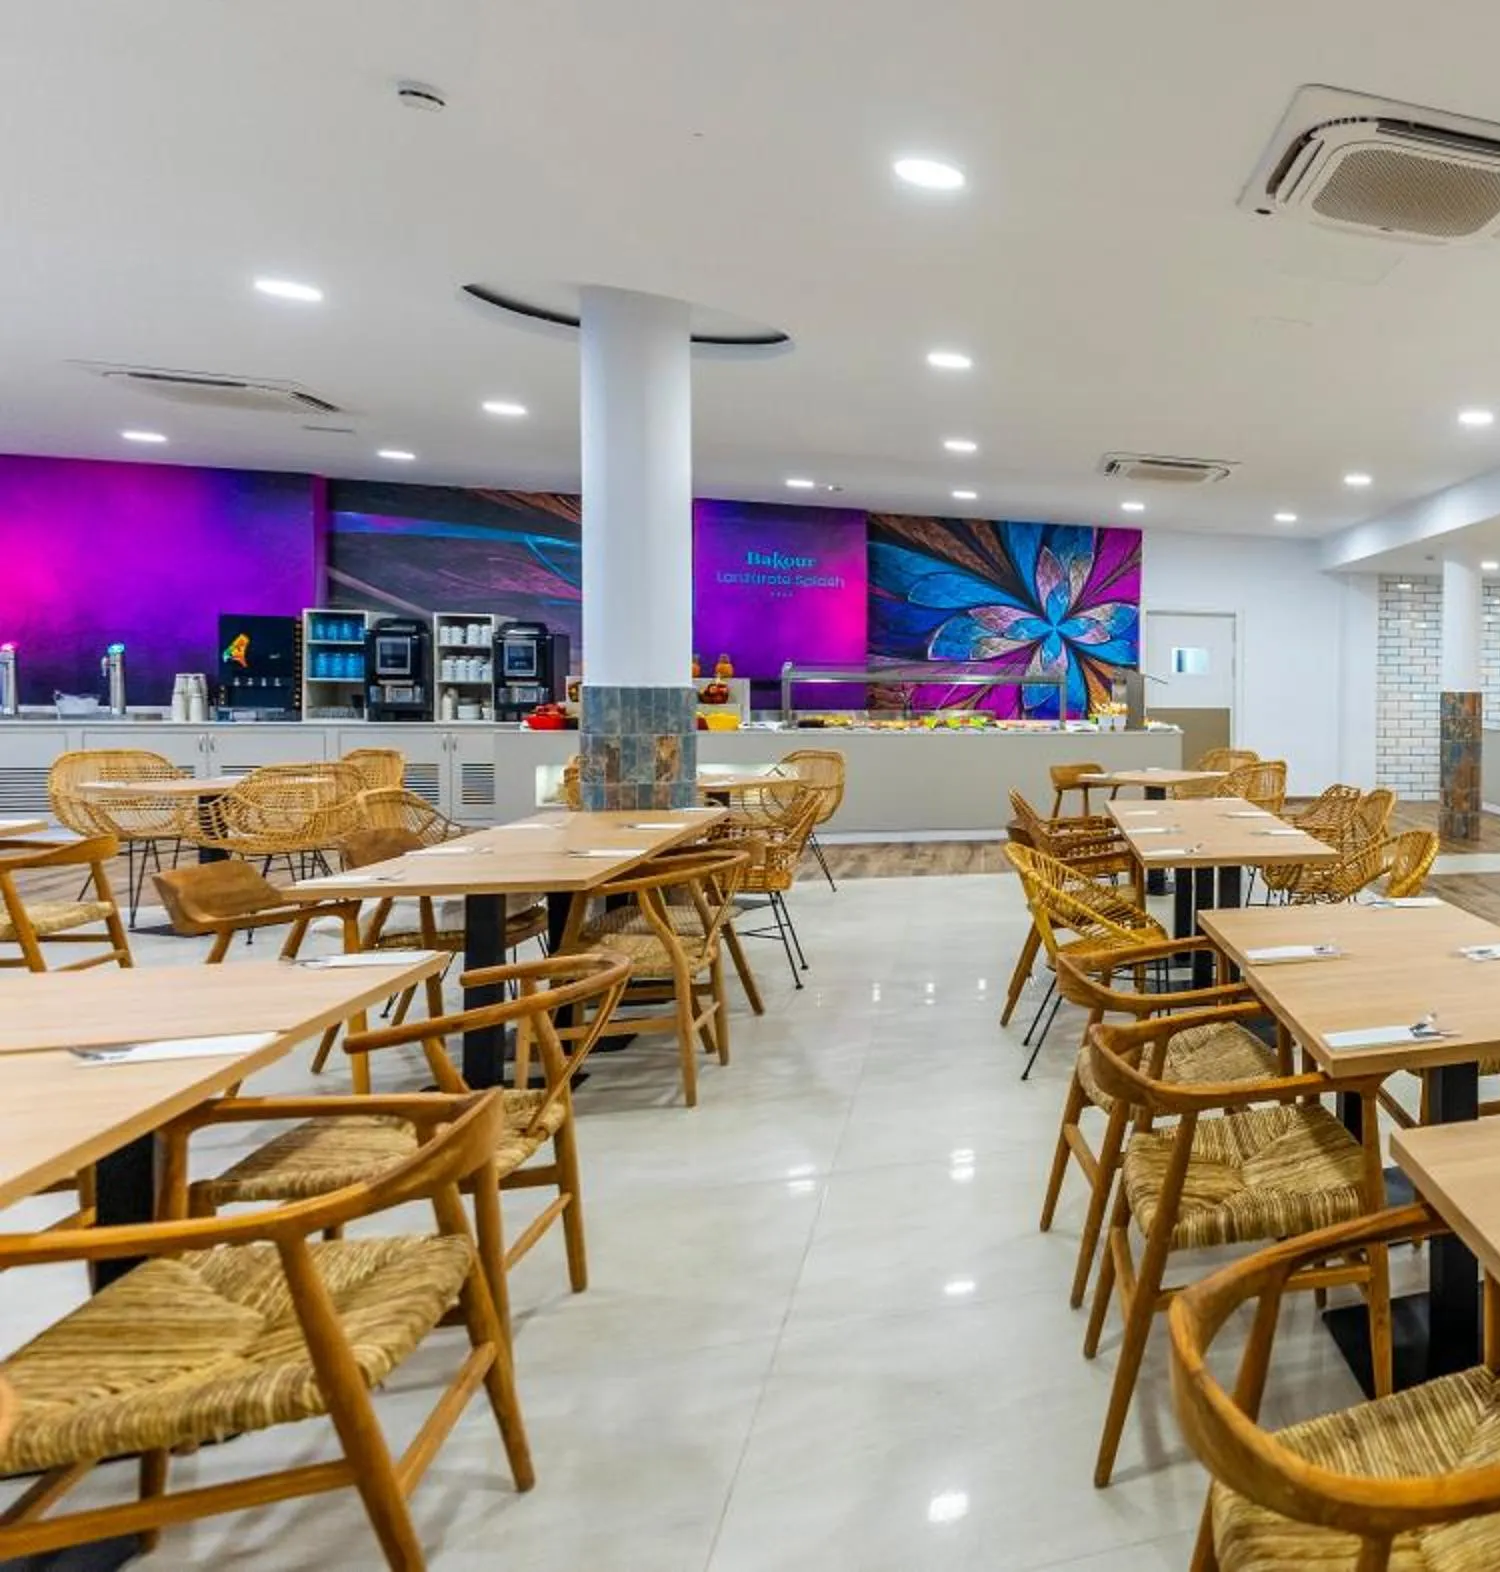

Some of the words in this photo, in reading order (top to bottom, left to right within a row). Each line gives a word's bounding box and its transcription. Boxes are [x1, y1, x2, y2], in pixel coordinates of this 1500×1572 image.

[747, 551, 818, 569] Bakour
[716, 571, 791, 585] Lanzarote
[794, 575, 845, 589] Splash
